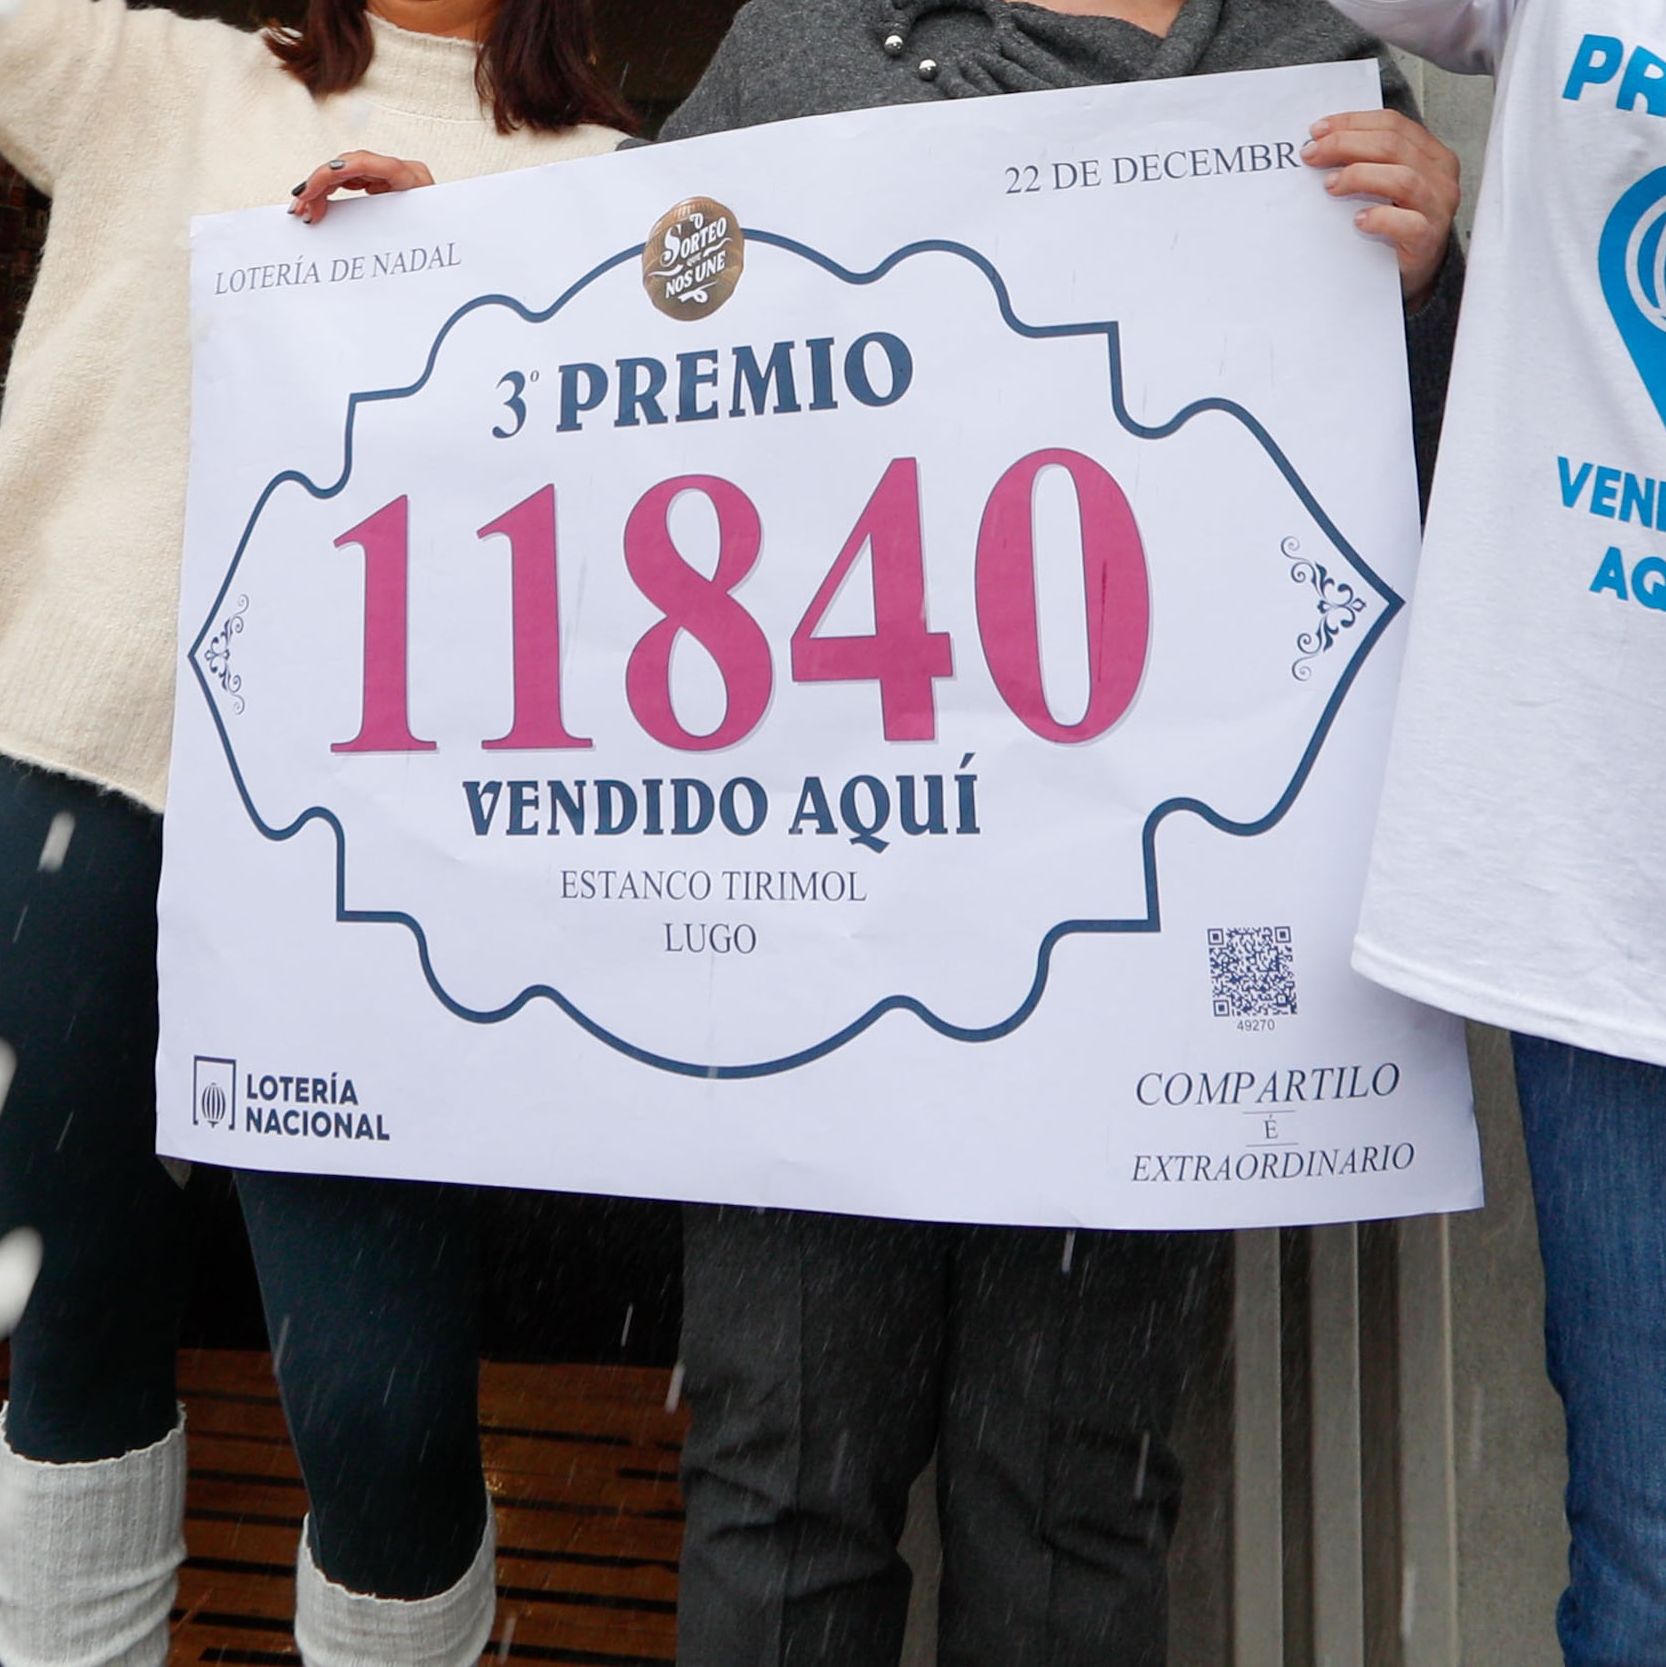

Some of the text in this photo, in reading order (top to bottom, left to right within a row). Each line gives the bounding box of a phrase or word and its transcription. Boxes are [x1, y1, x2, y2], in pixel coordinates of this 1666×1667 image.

[1005, 139, 1316, 194] 22 DE DECEMBR
[660, 216, 727, 267] SORTEO
[214, 242, 461, 295] LOTERÍA DE NADAL
[665, 250, 727, 299] NOS UNE
[556, 331, 913, 433] PREMIO
[330, 447, 1153, 754] 11840
[462, 752, 981, 854] VENDIDO AQUÍ
[561, 870, 868, 902] ESTANCO TIRIMOL
[664, 923, 757, 955] LUGO
[1237, 1019, 1276, 1031] 49270
[246, 1072, 359, 1105] LOTERÍA
[1136, 1062, 1401, 1105] COMPARTILO
[246, 1106, 391, 1141] NACIONAL
[1131, 1142, 1415, 1182] EXTRAORDINARIO
